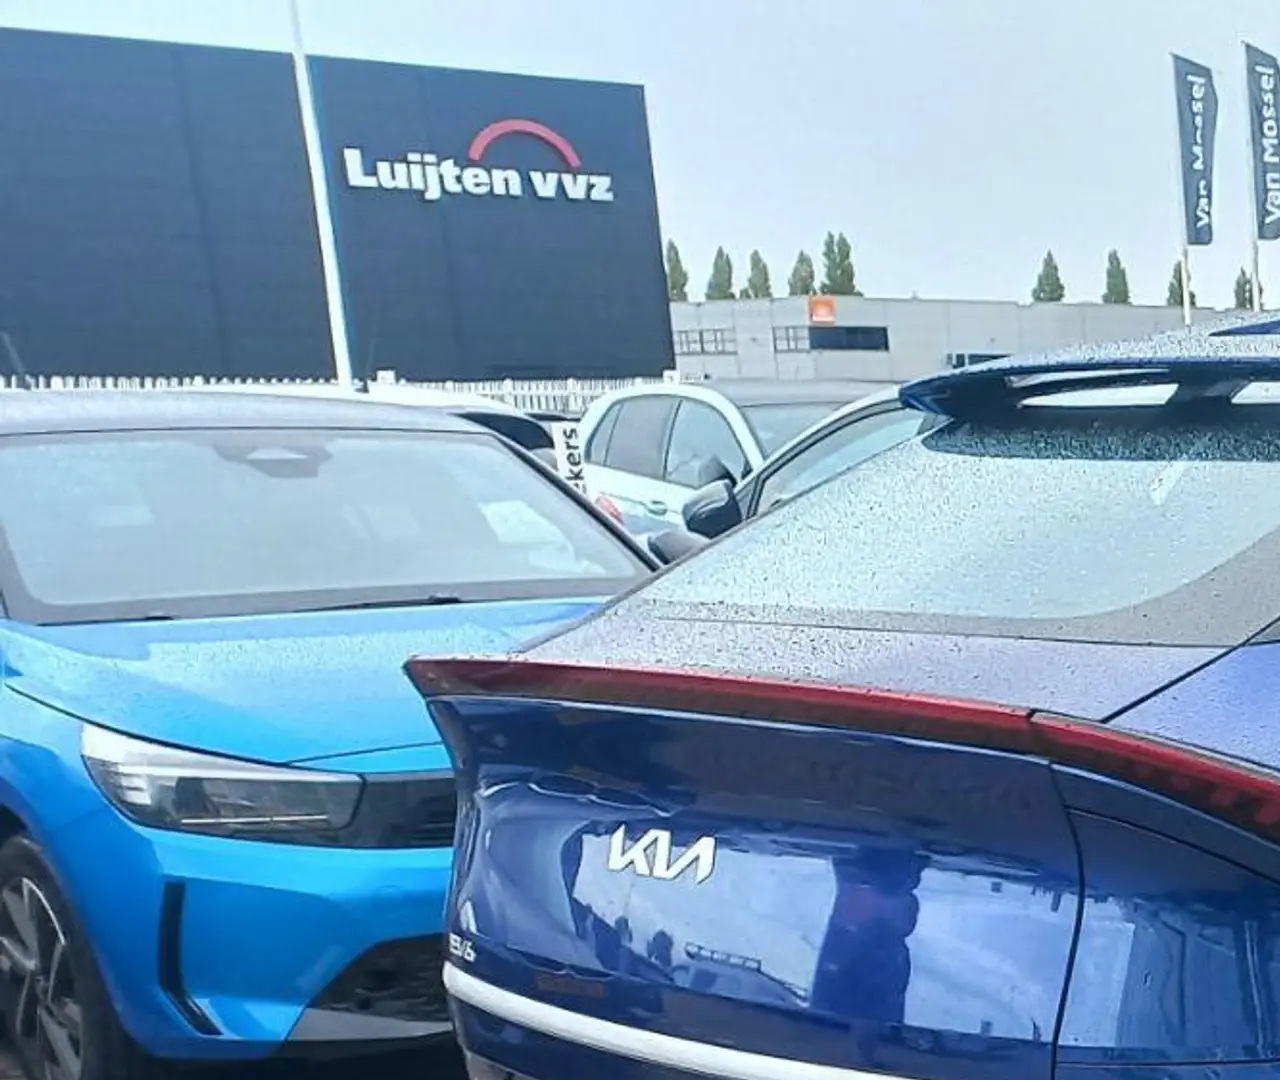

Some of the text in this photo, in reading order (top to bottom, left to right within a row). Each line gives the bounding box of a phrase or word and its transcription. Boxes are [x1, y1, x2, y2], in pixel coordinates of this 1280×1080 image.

[1254, 65, 1280, 163] Mossel
[343, 147, 614, 201] Luijten vvz
